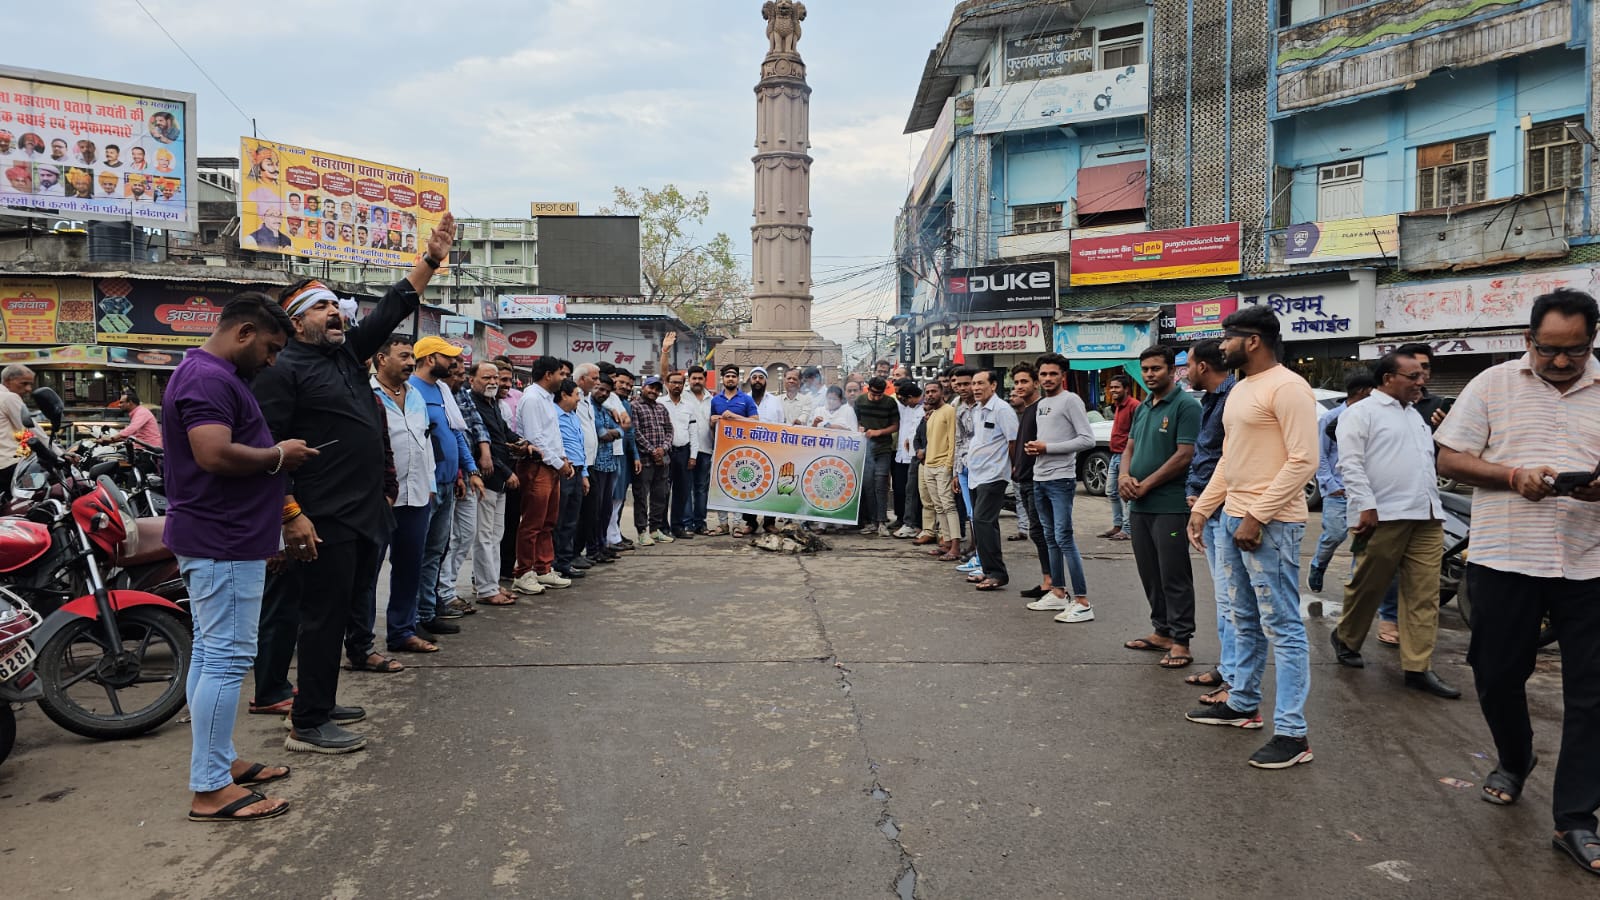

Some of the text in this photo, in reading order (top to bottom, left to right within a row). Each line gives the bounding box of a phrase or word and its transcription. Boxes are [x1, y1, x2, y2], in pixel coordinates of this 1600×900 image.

[14, 93, 61, 111] महाराणा
[63, 100, 92, 115] प्रताप
[95, 103, 127, 120] जयंती
[130, 107, 145, 122] की
[17, 112, 46, 128] बधाई
[49, 116, 66, 130] एवं
[311, 156, 414, 186] महाराणा प्रताप जयंती
[32, 198, 45, 208] एवं
[81, 202, 99, 213] सेना
[535, 203, 575, 212] SPOT ON
[1145, 243, 1161, 252] pnb
[1164, 239, 1187, 248] punjab
[1187, 236, 1213, 245] national
[969, 271, 1051, 293] DUKE
[7, 300, 49, 310] अग्रवाल
[1205, 304, 1219, 314] pnb
[962, 320, 1039, 339] Prakash
[1291, 314, 1351, 334] मोबाईल
[572, 340, 613, 353] अमन
[974, 340, 1026, 351] DRESSES
[781, 429, 798, 446] सेवा
[801, 434, 816, 447] दल
[819, 434, 834, 448] यंग
[837, 435, 860, 451] ब्रिगेड
[0, 646, 32, 679] 6287
